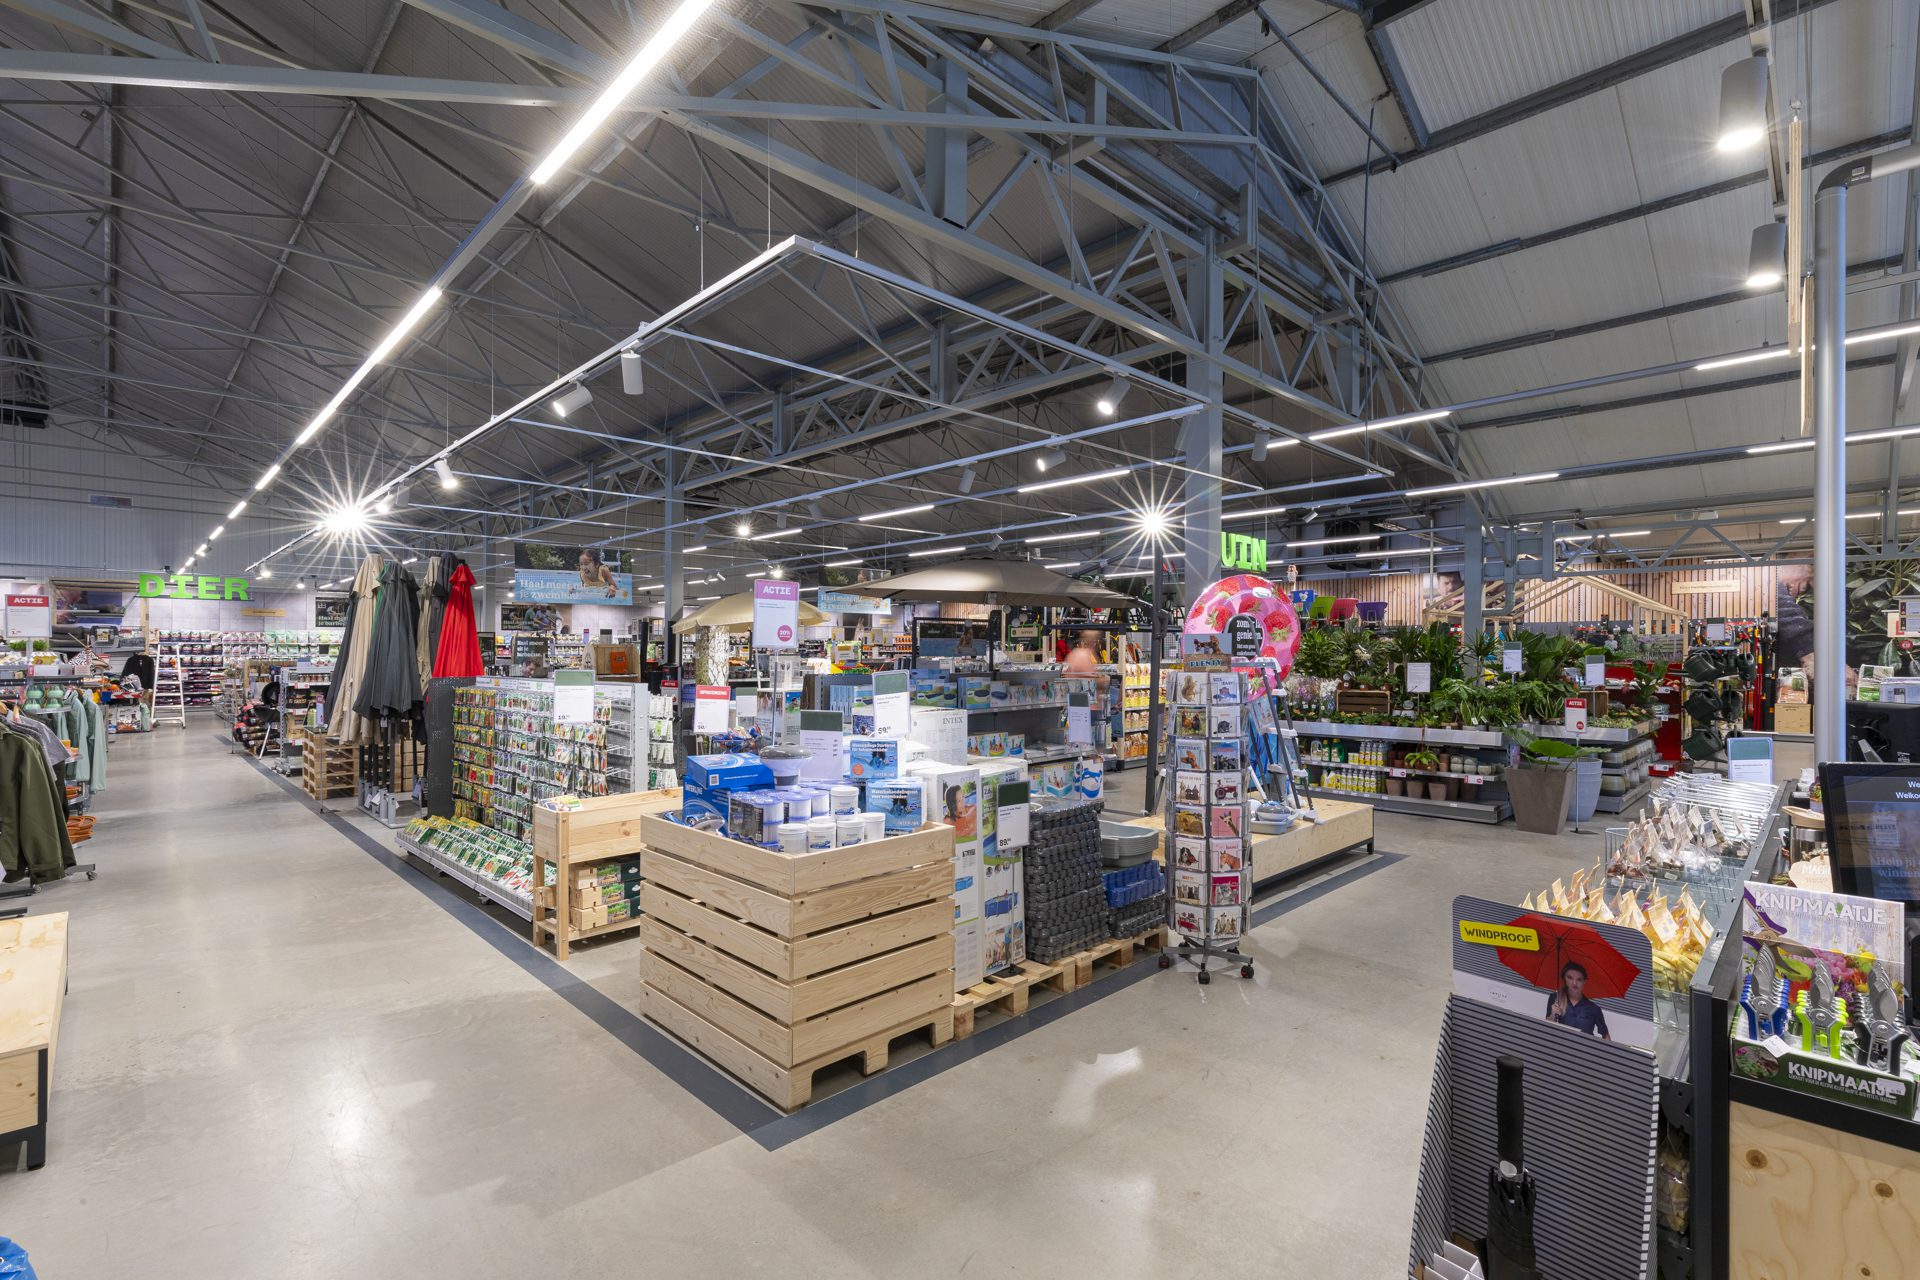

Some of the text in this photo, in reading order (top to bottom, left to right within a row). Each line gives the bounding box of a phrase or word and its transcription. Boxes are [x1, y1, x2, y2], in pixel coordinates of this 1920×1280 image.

[139, 573, 249, 600] DIER
[520, 579, 544, 589] Haal
[762, 585, 791, 595] ACTIE
[943, 716, 964, 725] INTEX
[1755, 892, 1887, 925] KNIPMAATJE
[1464, 927, 1533, 943] WINDPROOF
[1788, 1061, 1897, 1099] KNIPMAATJE
